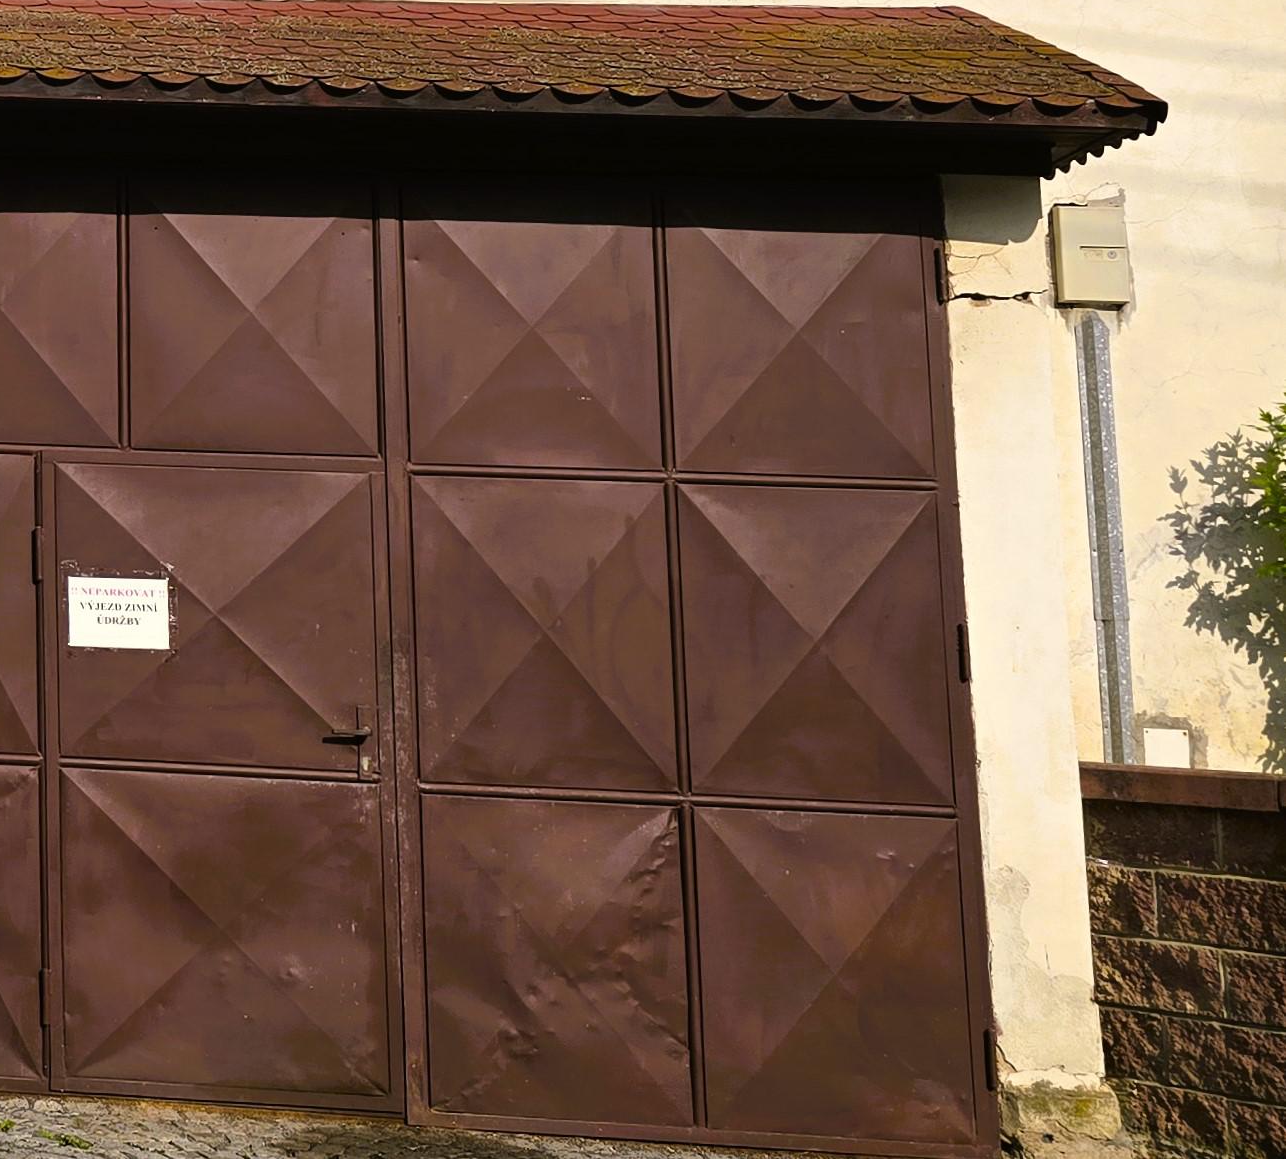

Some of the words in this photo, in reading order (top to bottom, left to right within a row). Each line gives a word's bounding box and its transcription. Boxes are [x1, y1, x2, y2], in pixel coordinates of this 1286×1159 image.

[82, 587, 155, 597] NEPARKOVAT
[80, 600, 122, 611] VÝJEZD
[124, 603, 158, 612] ZIMNÍ
[97, 614, 141, 625] ÚDRŽBY
